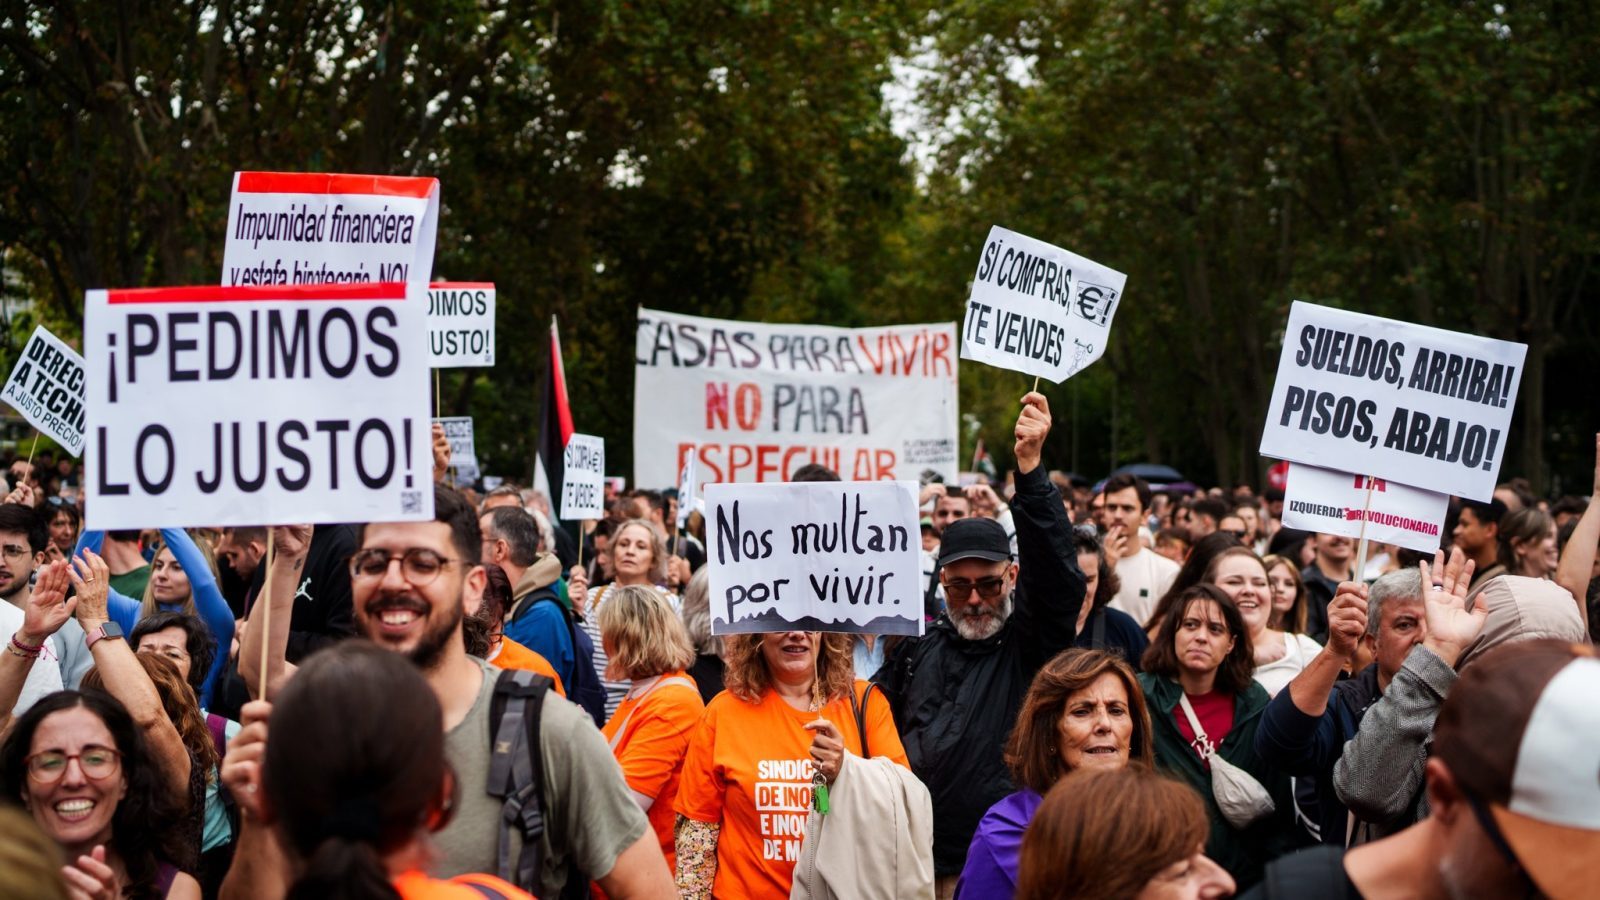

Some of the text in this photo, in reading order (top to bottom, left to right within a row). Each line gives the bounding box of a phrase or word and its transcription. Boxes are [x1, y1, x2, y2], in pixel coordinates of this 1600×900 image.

[235, 203, 415, 250] Impunidad financiera
[241, 258, 287, 286] estafa
[997, 247, 1072, 316] COMPRAS,
[107, 306, 400, 403] ¡PEDIMOS
[430, 329, 489, 356] USTO!
[768, 334, 864, 375] PARA
[966, 301, 1065, 368] TE VENDES
[13, 361, 32, 388] A
[1295, 324, 1515, 409] SUELDOS, ARRIBA!
[6, 384, 82, 450] A JUSTO PRECIO!
[705, 381, 869, 434] NO PARA
[1279, 385, 1500, 472] PISOS, ABAJO!
[98, 417, 413, 496] LO JUSTO!
[717, 492, 908, 565] Nos multan
[726, 566, 900, 624] por vivir.
[758, 759, 815, 780] SINDIC
[759, 786, 811, 810] DE INQ
[760, 814, 770, 836] E
[763, 839, 800, 862] DE M
